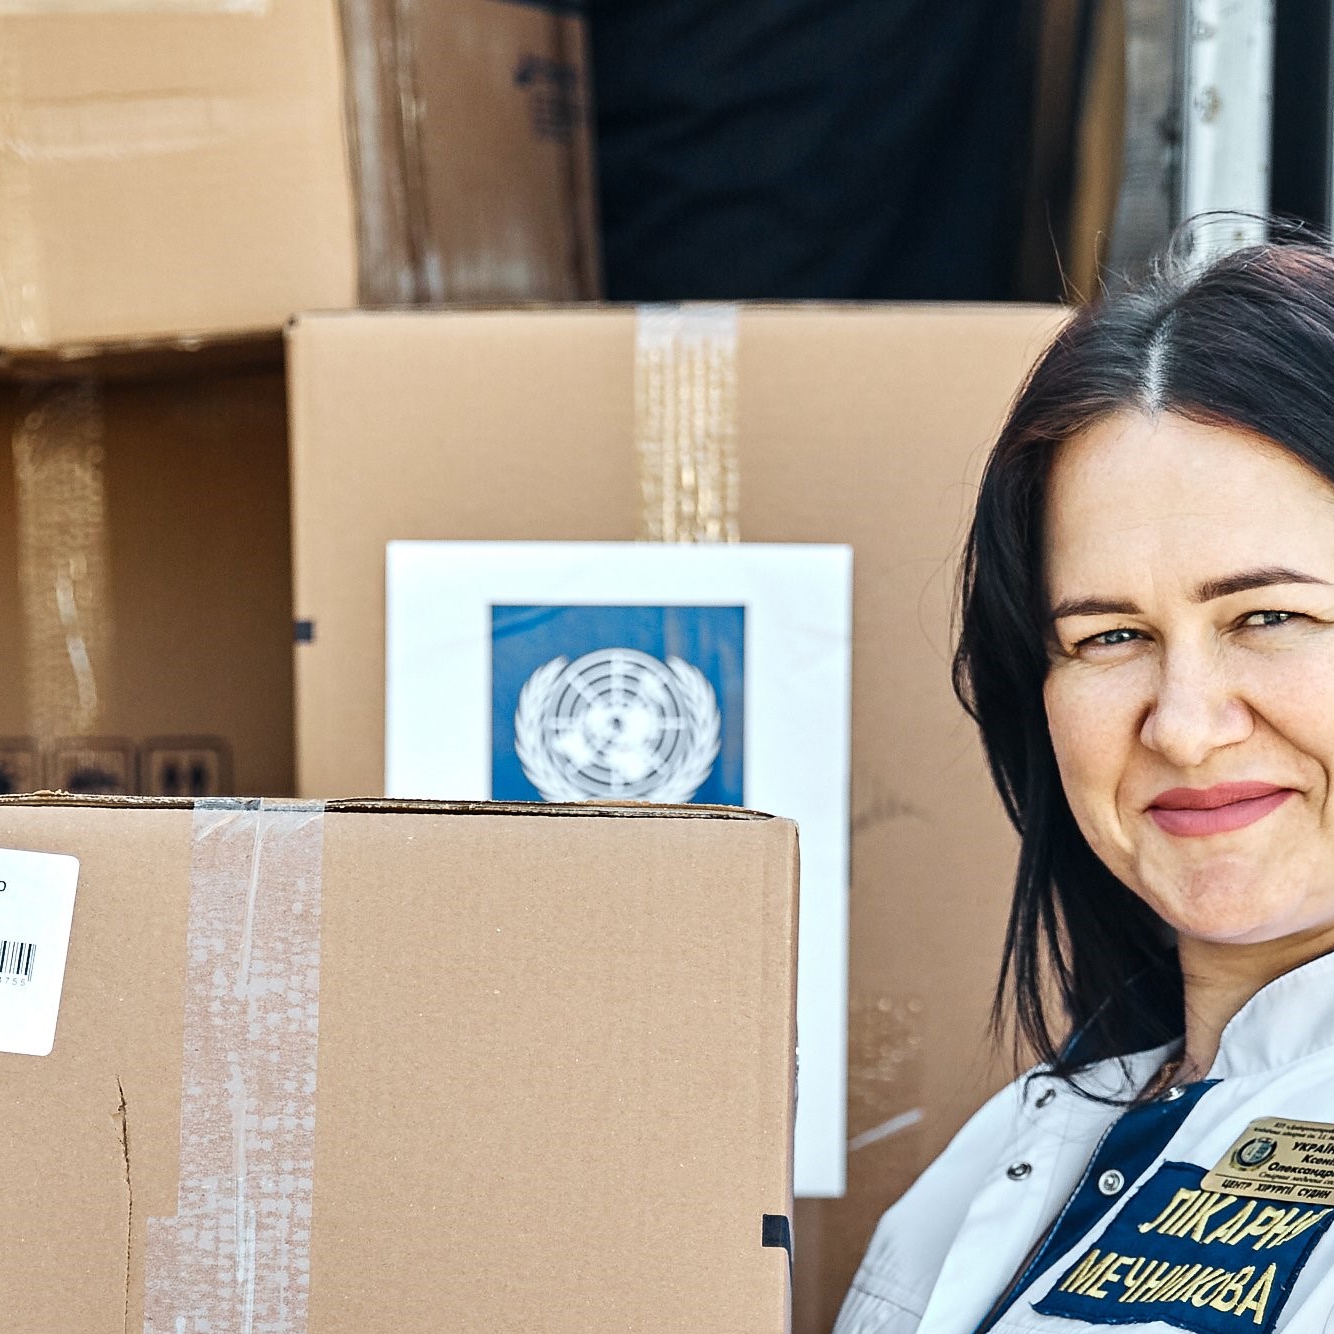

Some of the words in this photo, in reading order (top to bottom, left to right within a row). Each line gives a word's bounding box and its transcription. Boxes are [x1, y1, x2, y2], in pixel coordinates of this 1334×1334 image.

[1221, 1179, 1252, 1191] ЦЕНТР
[1297, 1187, 1333, 1200] СУДИН
[1058, 1248, 1277, 1325] МЕЧНИКОВА
